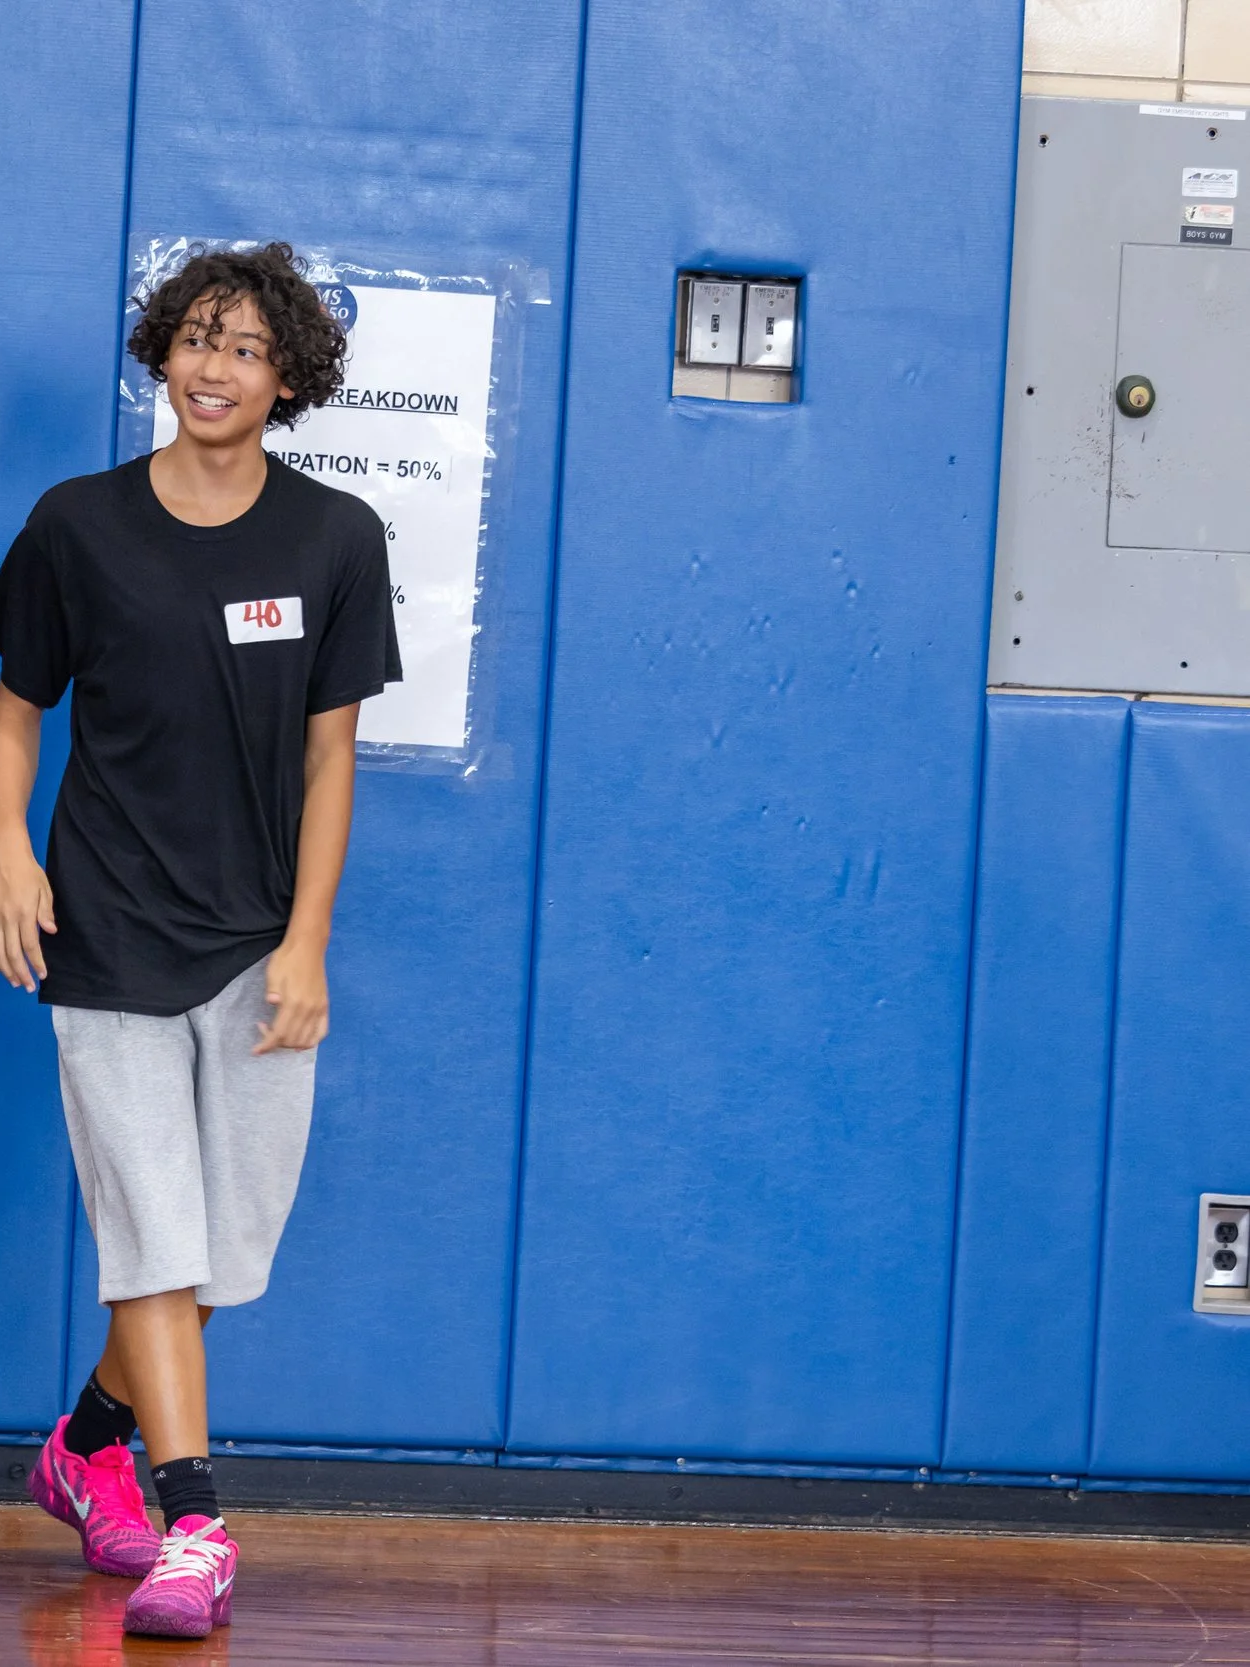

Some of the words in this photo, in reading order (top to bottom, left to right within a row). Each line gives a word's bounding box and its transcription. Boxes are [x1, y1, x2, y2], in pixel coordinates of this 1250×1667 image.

[1186, 230, 1206, 239] BOYS
[1209, 232, 1226, 240] GYM
[377, 462, 389, 472] =
[397, 460, 441, 480] 50%
[243, 600, 282, 628] 40
